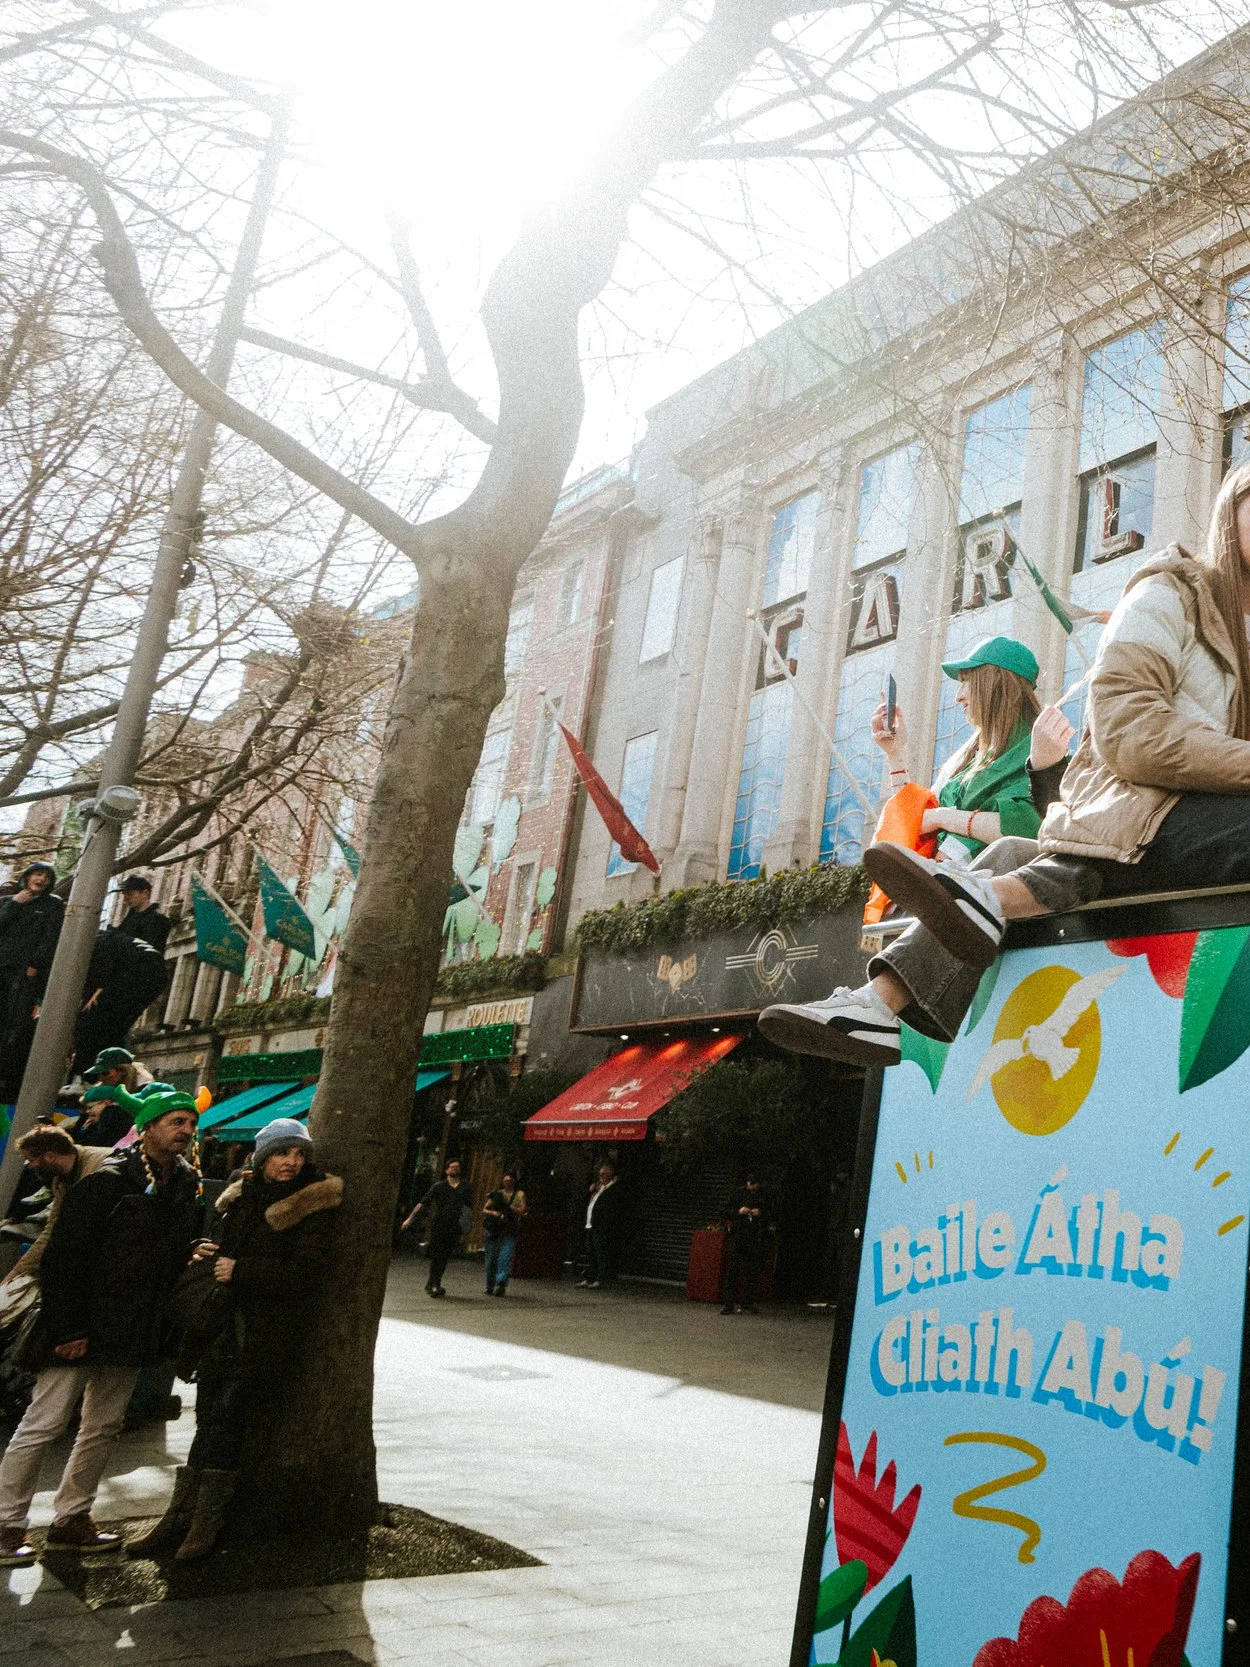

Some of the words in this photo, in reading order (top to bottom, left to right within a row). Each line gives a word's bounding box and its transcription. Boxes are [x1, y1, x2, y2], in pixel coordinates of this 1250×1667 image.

[467, 1001, 528, 1027] ROULETTE
[876, 1199, 1017, 1300] Baile
[1020, 1162, 1184, 1286] Átha
[874, 1306, 1033, 1393] Cliath
[1036, 1319, 1226, 1460] Abú!
